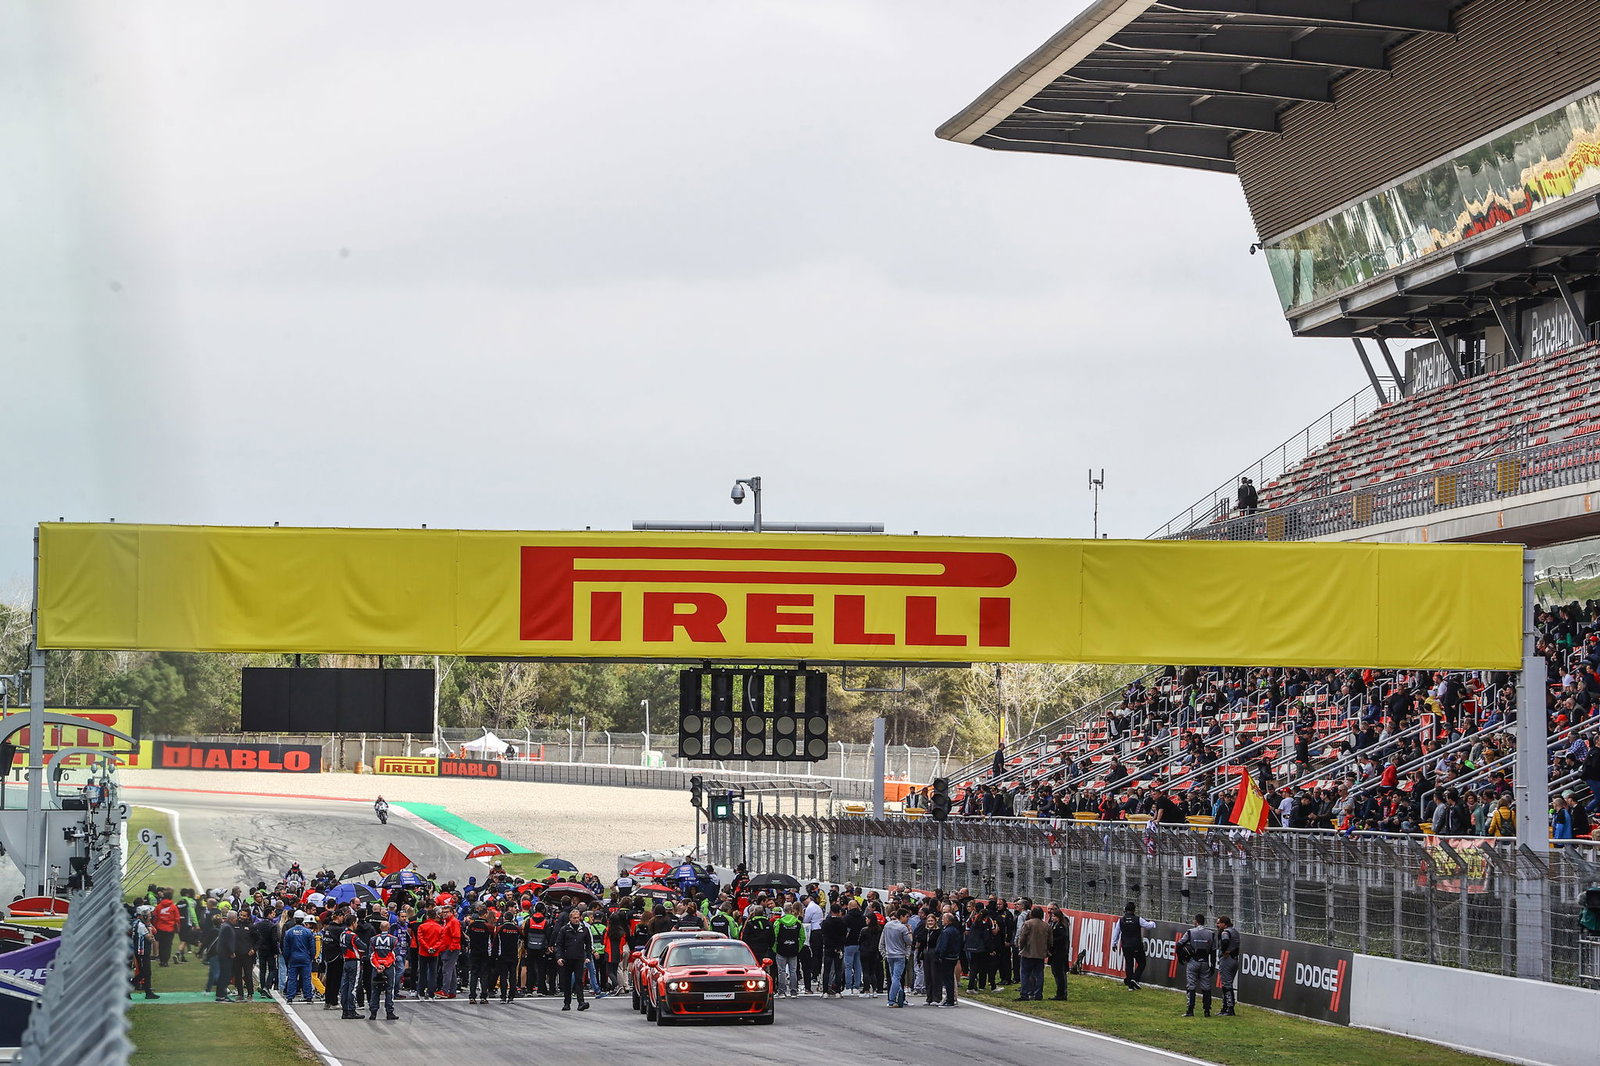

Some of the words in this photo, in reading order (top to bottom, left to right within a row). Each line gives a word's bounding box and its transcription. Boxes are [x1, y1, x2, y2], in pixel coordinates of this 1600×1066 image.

[1532, 303, 1574, 359] Barcelona
[1412, 344, 1450, 395] Barcelona
[520, 545, 1018, 648] PIRELLI
[162, 743, 311, 771] DIABLO
[379, 758, 436, 775] PIRELLI
[441, 761, 498, 777] DIABLO
[141, 829, 151, 843] 6
[152, 841, 160, 857] 1
[162, 851, 173, 867] 3
[375, 936, 390, 946] M
[1078, 917, 1105, 968] MOTUL
[1143, 937, 1176, 961] DODGE
[1241, 953, 1282, 981] DODGE
[1295, 962, 1339, 993] DODGE
